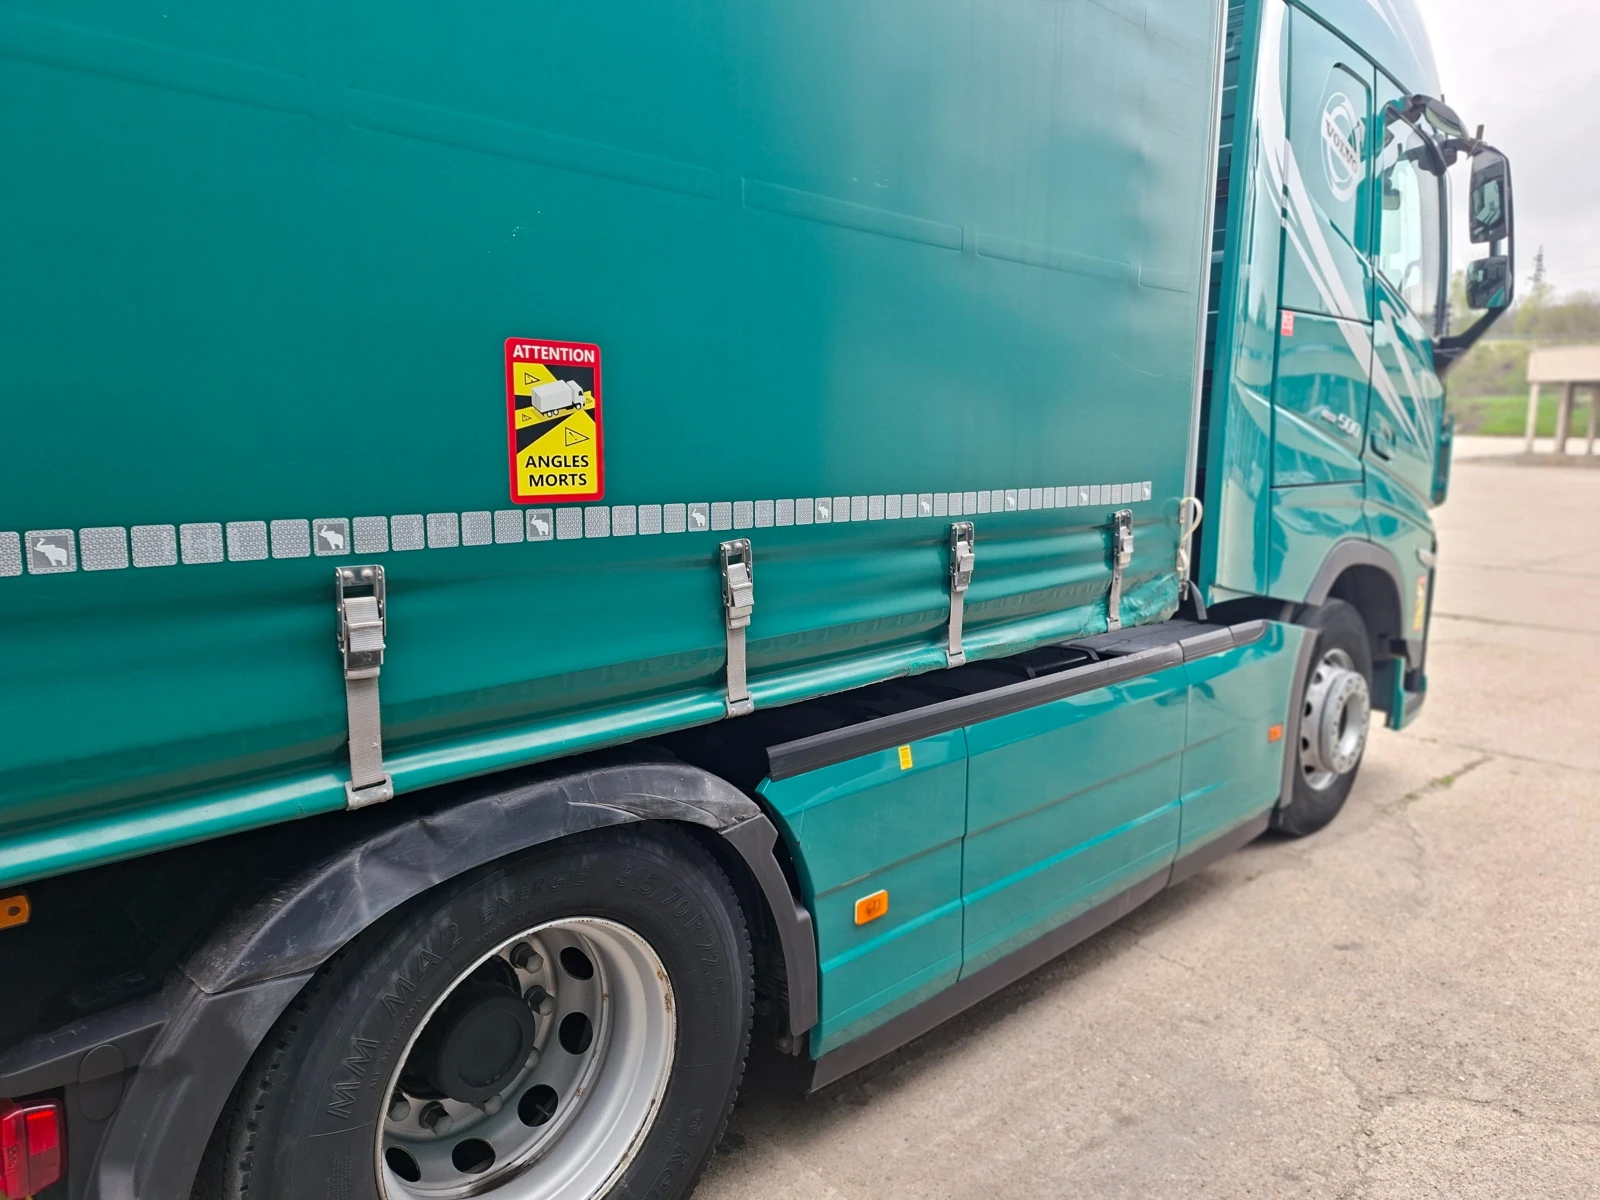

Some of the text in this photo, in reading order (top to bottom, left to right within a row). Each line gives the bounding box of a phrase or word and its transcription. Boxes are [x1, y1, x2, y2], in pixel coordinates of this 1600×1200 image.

[1325, 119, 1358, 174] VOLVO
[513, 344, 595, 363] ATTENTION
[525, 454, 589, 468] ANGLES
[529, 473, 587, 487] MORTS
[326, 1037, 380, 1121] MM
[480, 866, 590, 926] ENERGIE
